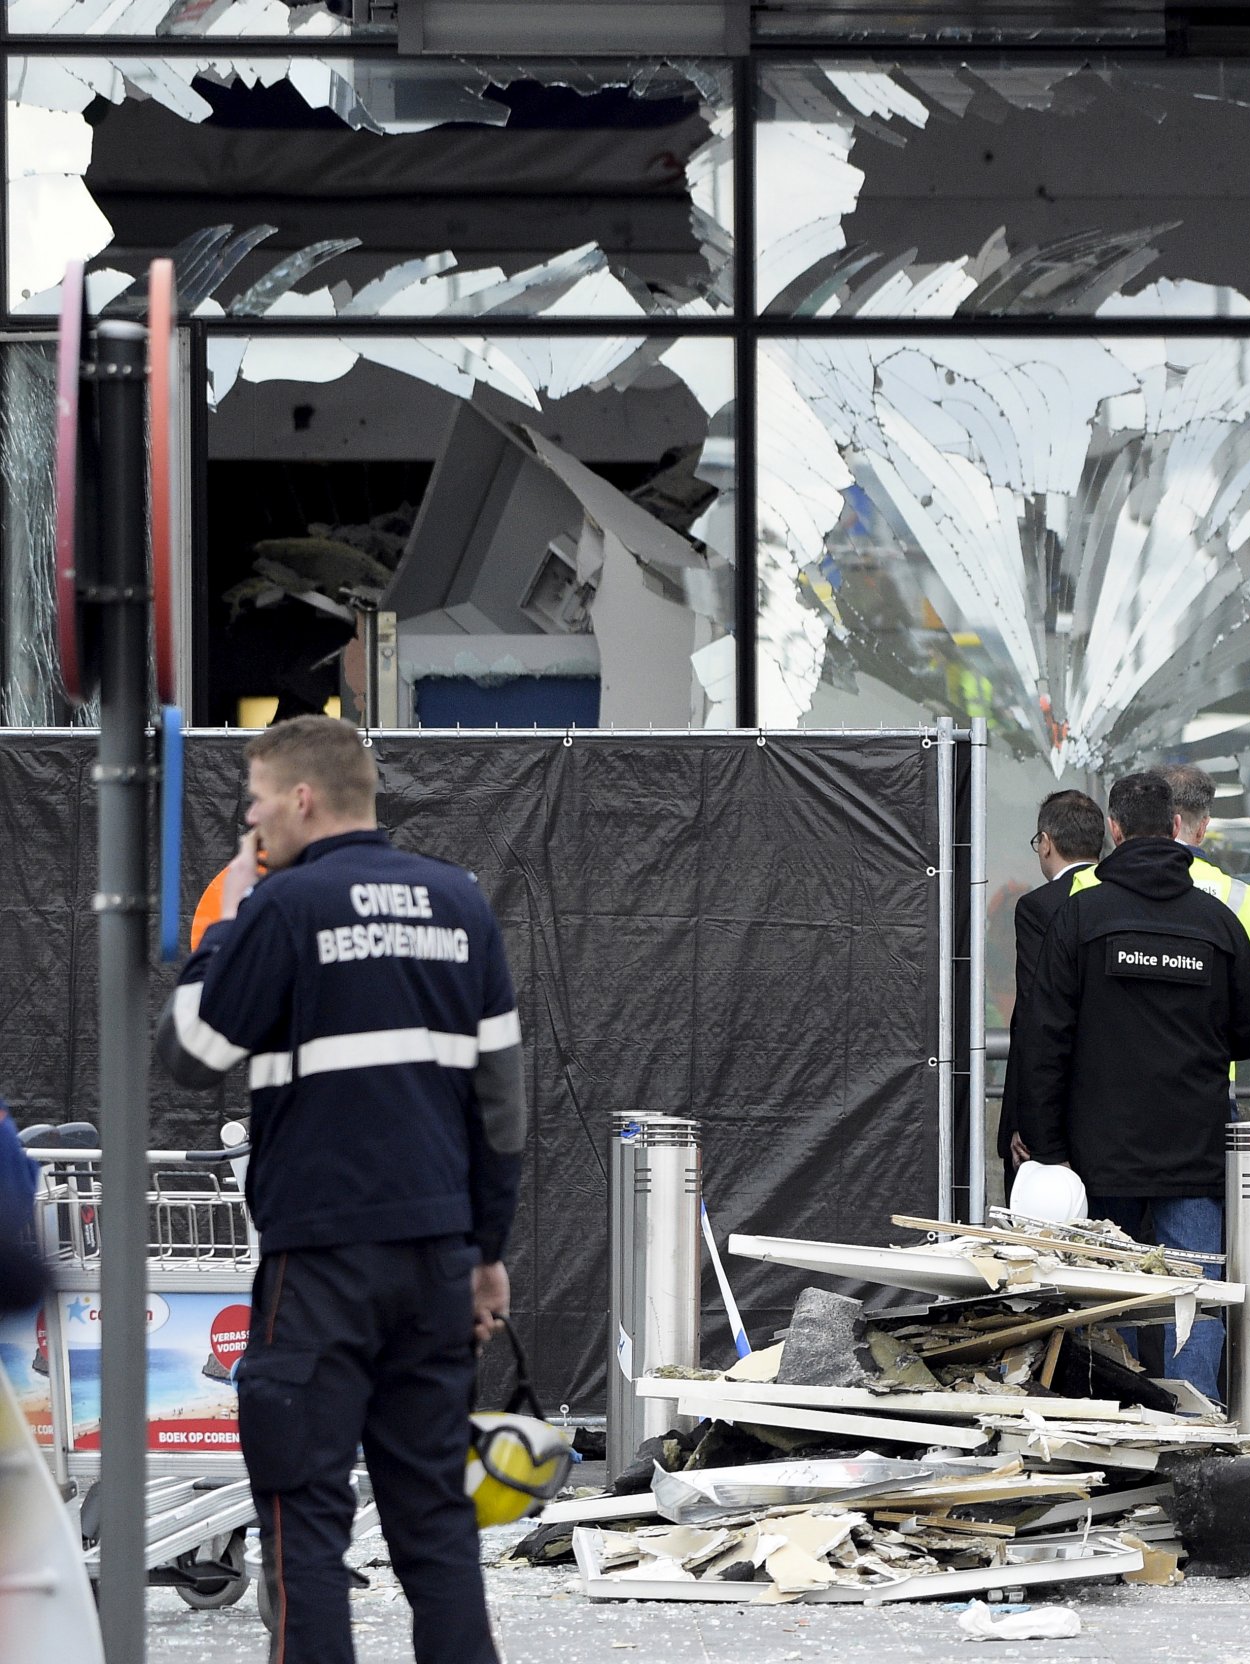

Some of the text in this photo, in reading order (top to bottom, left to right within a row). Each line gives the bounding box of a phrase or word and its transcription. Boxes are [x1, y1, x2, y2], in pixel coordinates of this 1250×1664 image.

[350, 883, 433, 919] CIVIELE
[316, 922, 470, 965] BESCHERMING
[1118, 951, 1204, 971] Police Politie
[158, 1432, 188, 1443] BOEK
[189, 1432, 204, 1443] OP
